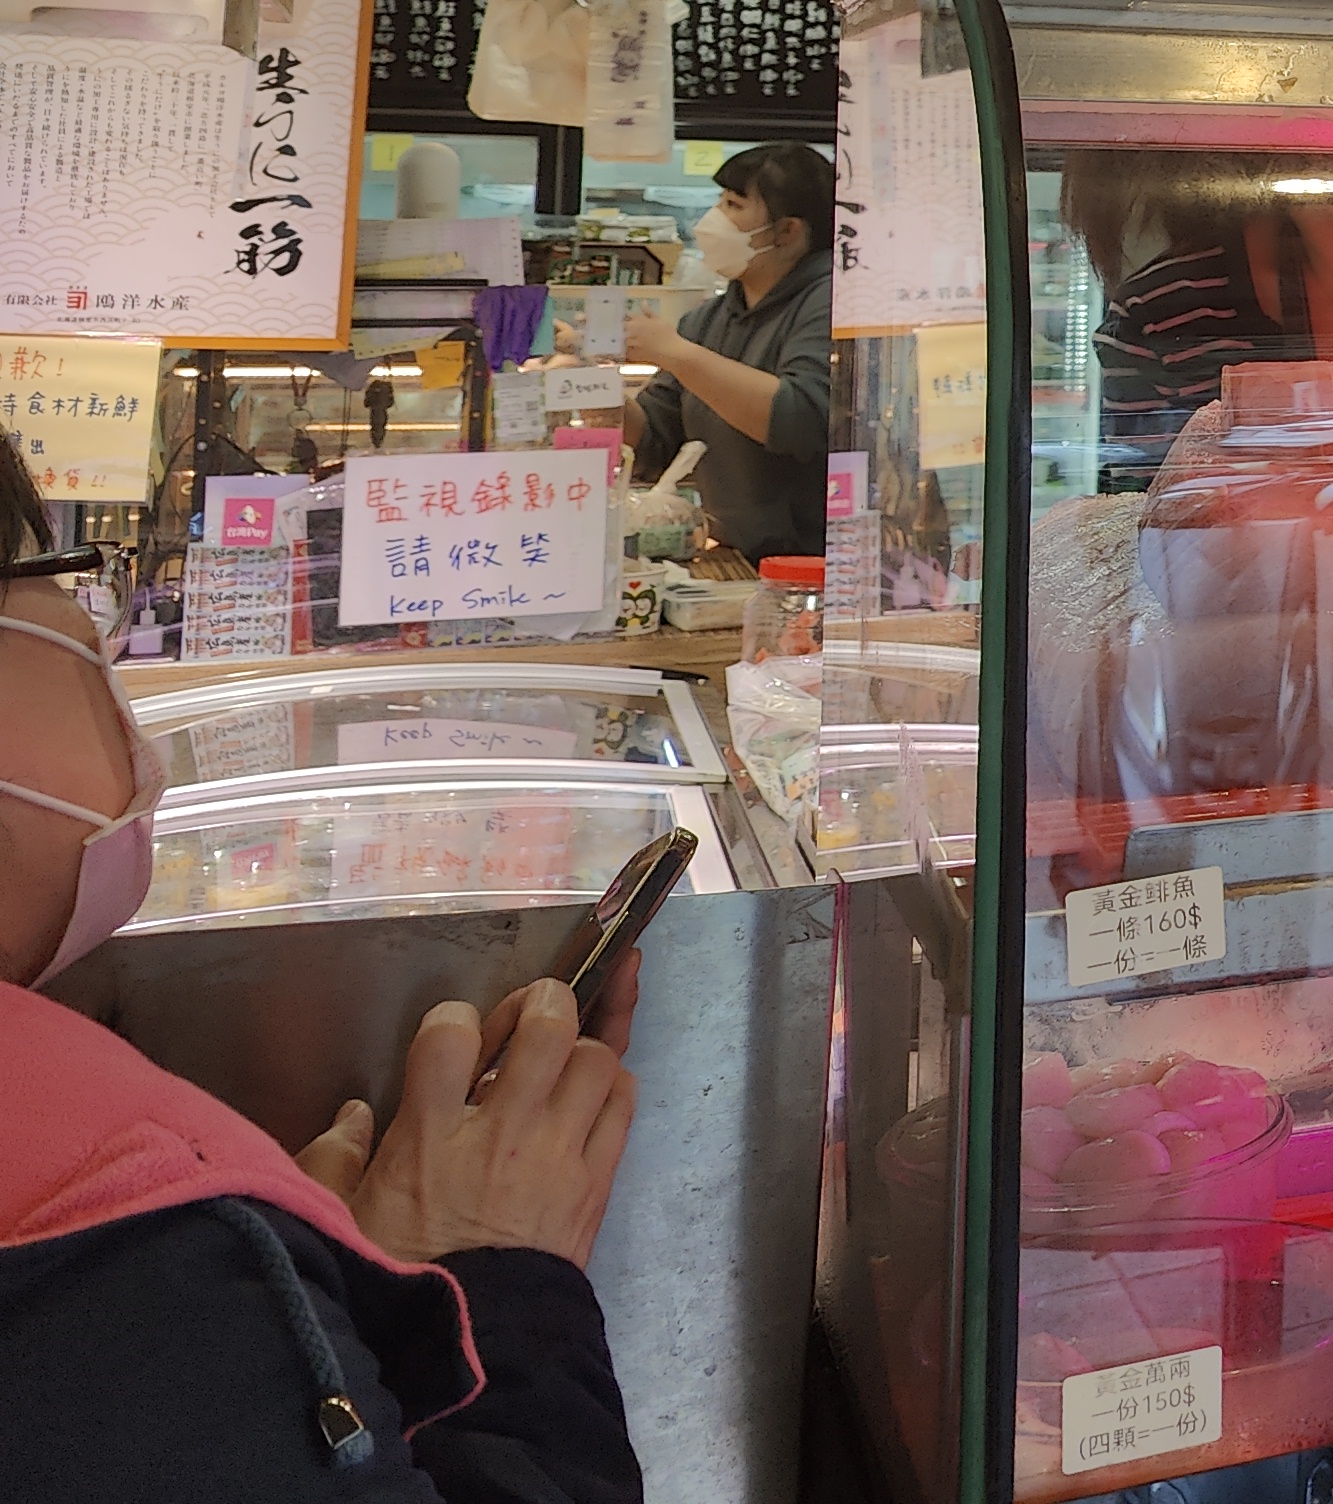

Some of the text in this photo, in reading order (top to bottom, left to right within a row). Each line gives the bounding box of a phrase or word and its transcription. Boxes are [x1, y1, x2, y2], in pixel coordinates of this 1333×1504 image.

[223, 47, 312, 280] 生うに一筋
[0, 346, 63, 380] 歉!
[366, 471, 591, 523] 監視錄影中
[385, 533, 551, 578] 請微笑
[390, 595, 444, 617] Keep
[1092, 875, 1195, 916] 黃金鯡魚
[1089, 902, 1202, 942] 一條160$
[1096, 1355, 1191, 1398] 黃金萬兩
[1092, 1383, 1195, 1422] 一份150$
[1079, 1409, 1206, 1460] (四顆=一份)
